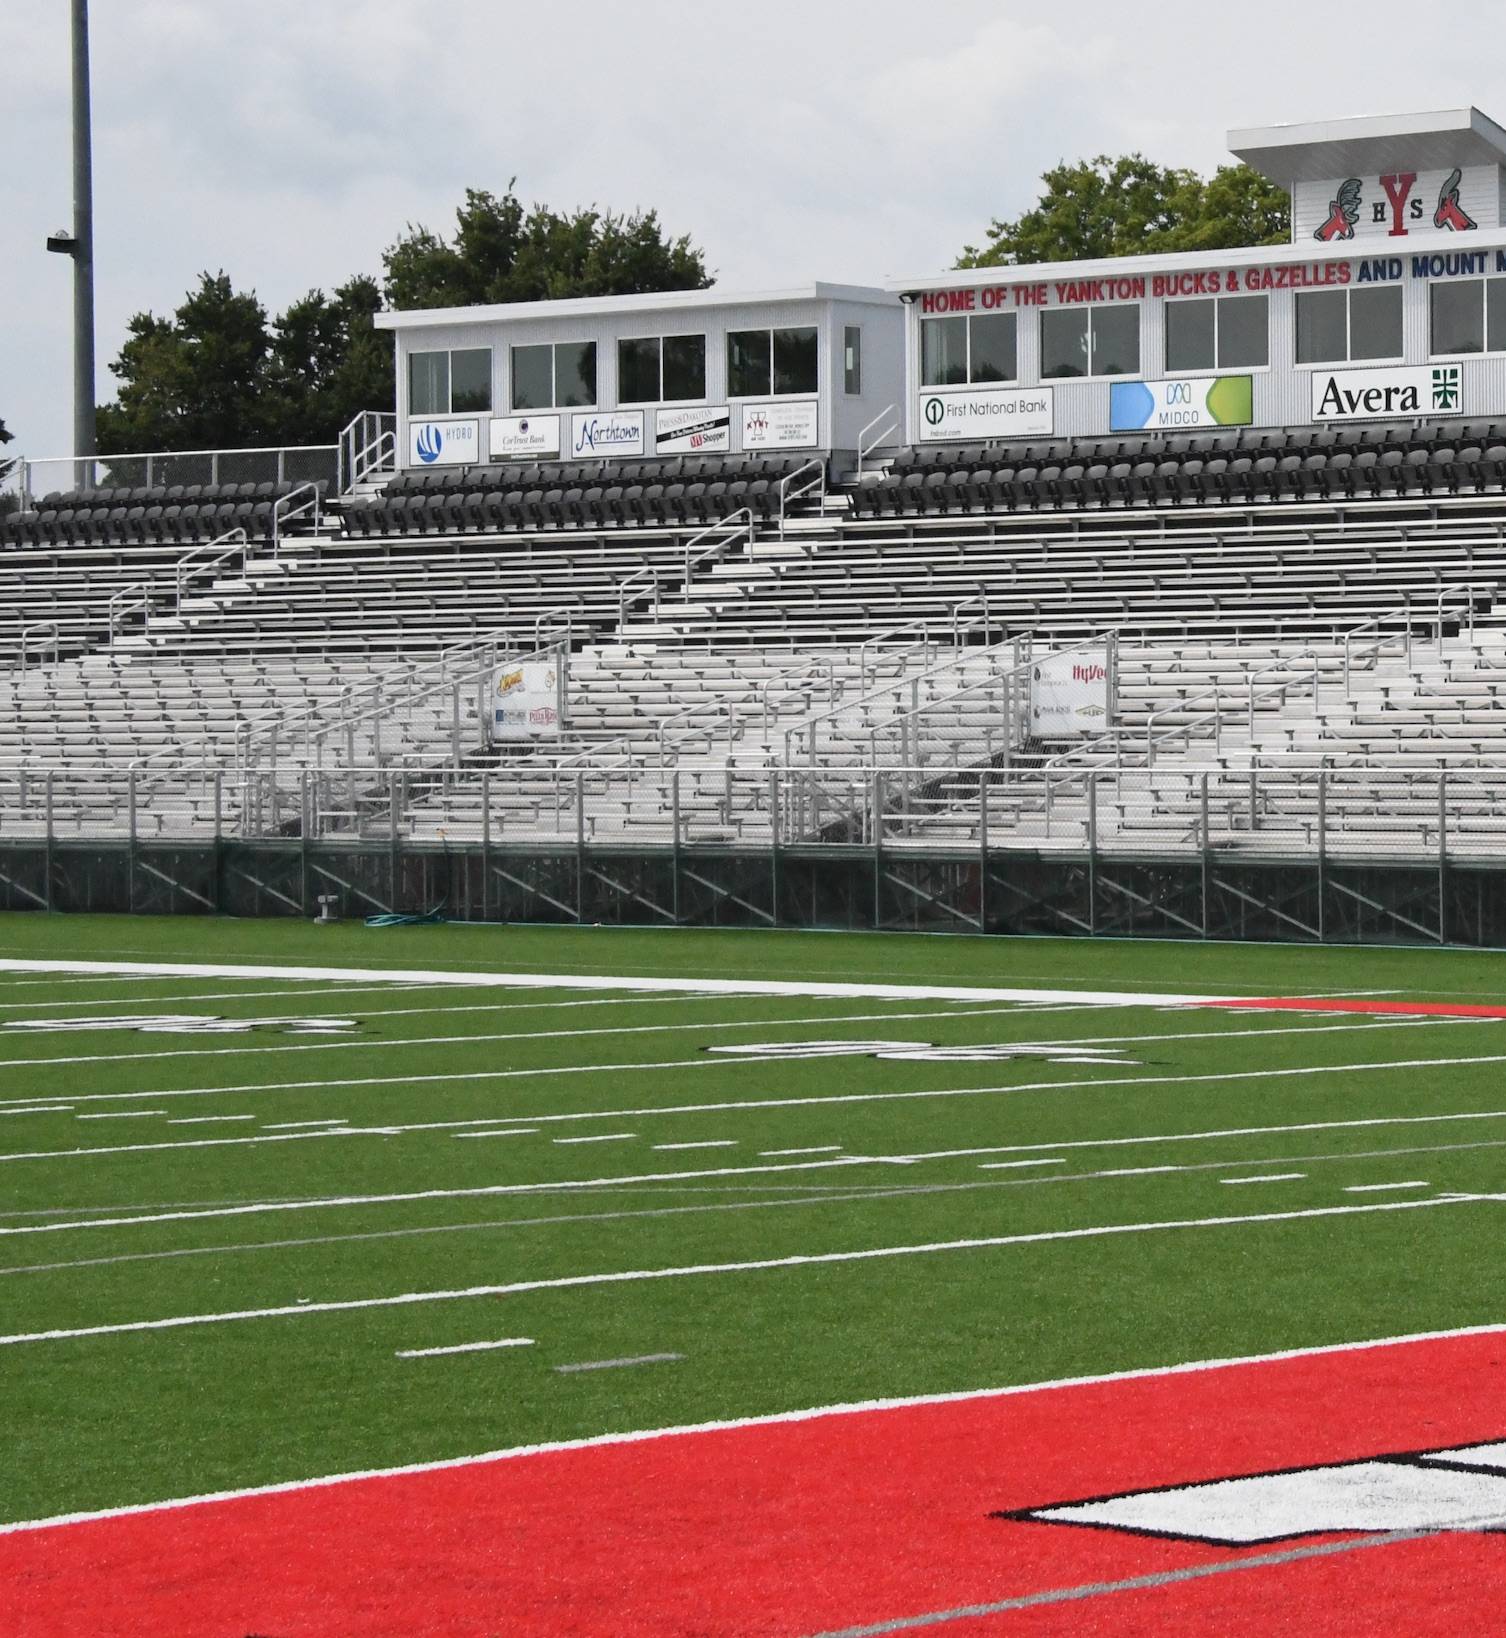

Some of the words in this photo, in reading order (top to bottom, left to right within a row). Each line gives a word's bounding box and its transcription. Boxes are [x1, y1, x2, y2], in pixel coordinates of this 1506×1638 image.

[922, 290, 976, 313] HOME
[981, 286, 1008, 309] OF
[1012, 283, 1048, 306] THE
[1055, 277, 1146, 303] YANKTON
[1152, 270, 1220, 297] BUCKS
[1226, 270, 1239, 292] &
[1245, 261, 1351, 291] GAZELLES
[1357, 258, 1403, 283] AND
[1412, 250, 1489, 279] MOUNT
[1317, 376, 1421, 416] Avera
[947, 403, 966, 417] First
[969, 400, 1017, 416] National
[1019, 399, 1047, 413] Bank
[746, 419, 769, 430] KYNT
[1158, 410, 1199, 424] MIDCO
[502, 435, 528, 445] CorTrust
[529, 434, 545, 444] Bank
[575, 417, 640, 452] Northtown
[702, 431, 726, 444] Shopper
